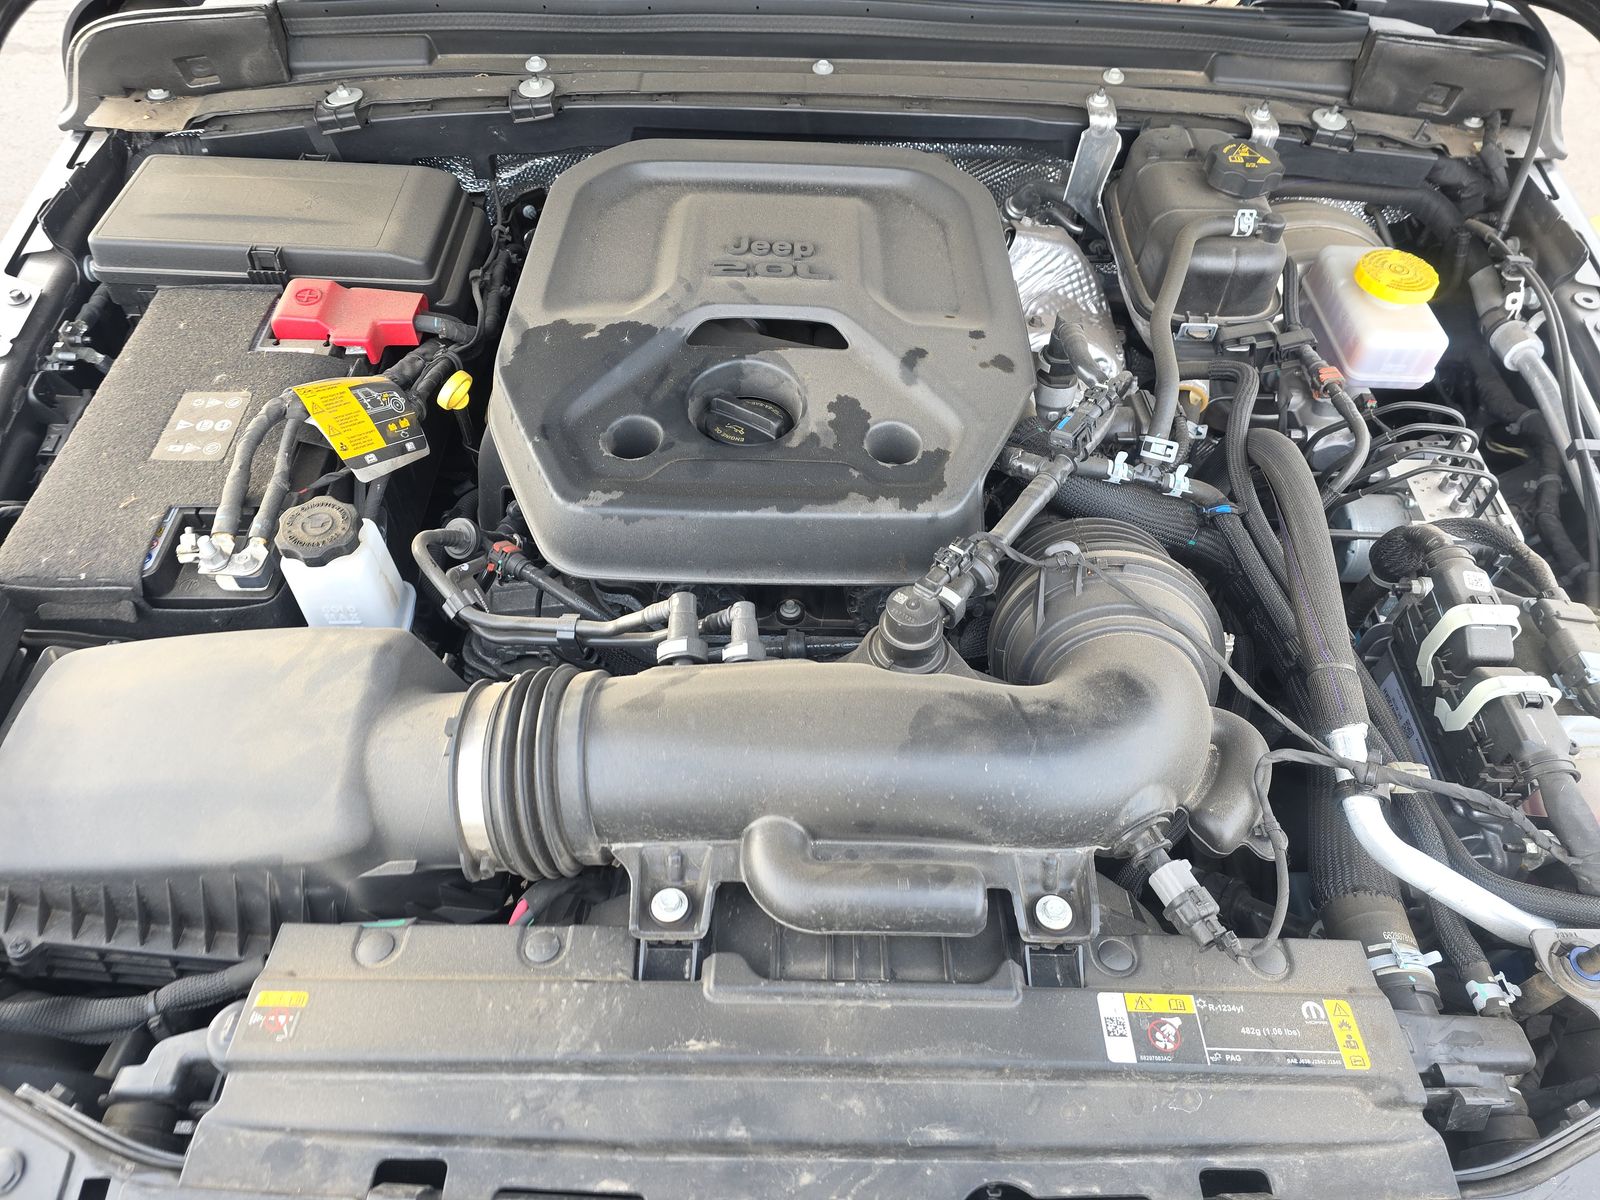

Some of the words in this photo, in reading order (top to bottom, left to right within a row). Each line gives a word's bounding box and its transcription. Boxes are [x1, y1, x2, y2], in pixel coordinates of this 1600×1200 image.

[726, 237, 816, 261] Jeep
[710, 261, 832, 280] 2.0L
[720, 432, 745, 442] ENGINE
[1241, 1027, 1261, 1036] 482g
